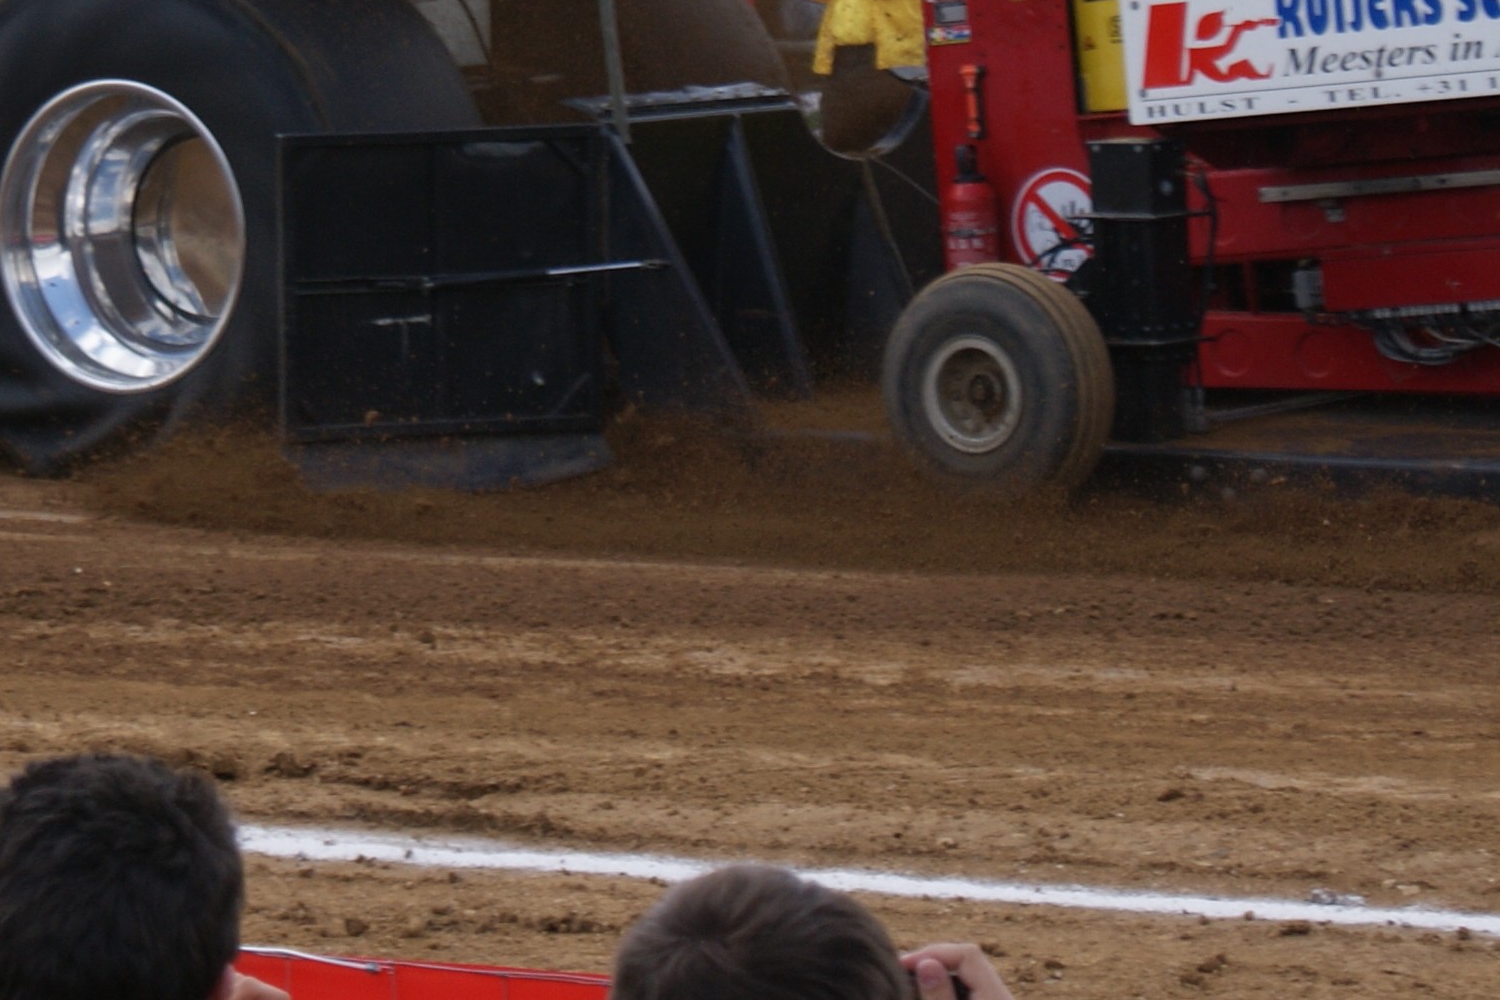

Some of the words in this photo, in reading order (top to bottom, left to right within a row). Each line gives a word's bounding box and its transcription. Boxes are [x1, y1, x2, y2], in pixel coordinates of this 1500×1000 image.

[1282, 44, 1438, 77] Meesters
[1450, 32, 1484, 62] in
[1147, 97, 1260, 119] HULST
